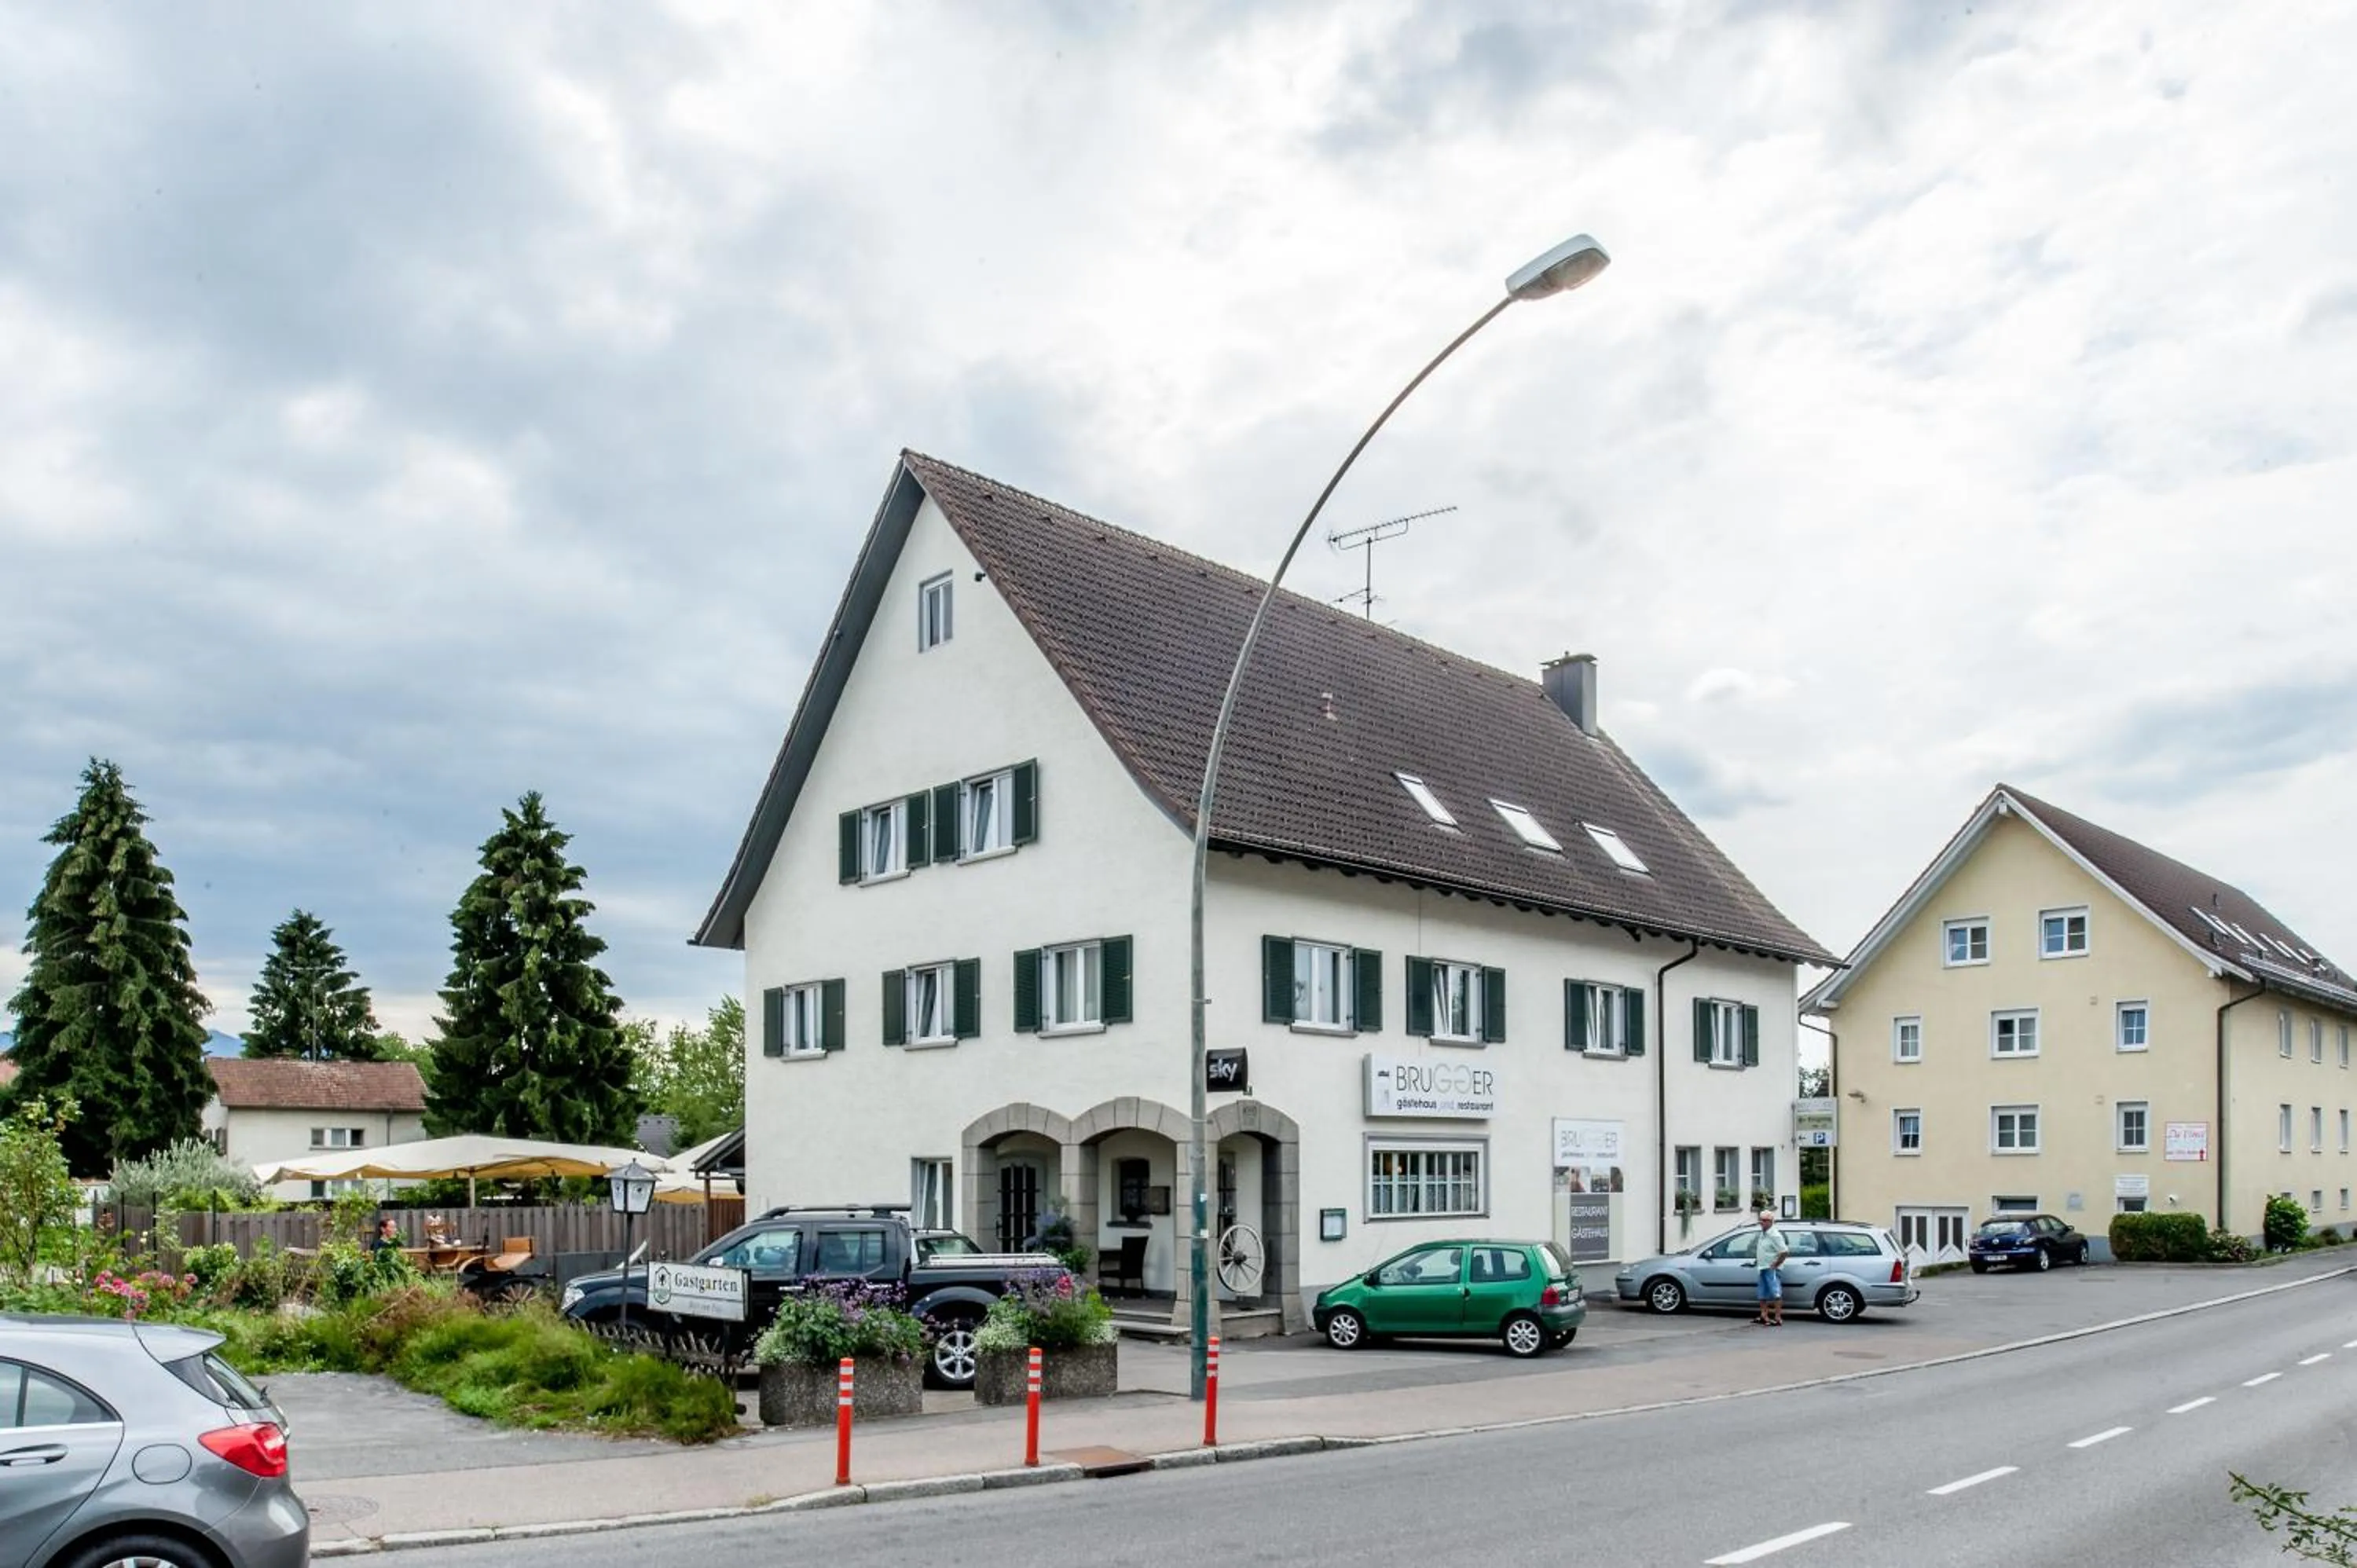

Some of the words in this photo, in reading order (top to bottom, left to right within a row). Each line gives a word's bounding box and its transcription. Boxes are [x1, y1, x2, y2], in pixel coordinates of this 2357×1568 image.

[1209, 1058, 1237, 1082] sky
[1396, 1063, 1493, 1095] BRUGGER
[1396, 1100, 1436, 1110] gästehaus
[1457, 1101, 1493, 1111] restaurant
[1560, 1130, 1618, 1148] BRUER
[675, 1272, 738, 1293] Gastgarten
